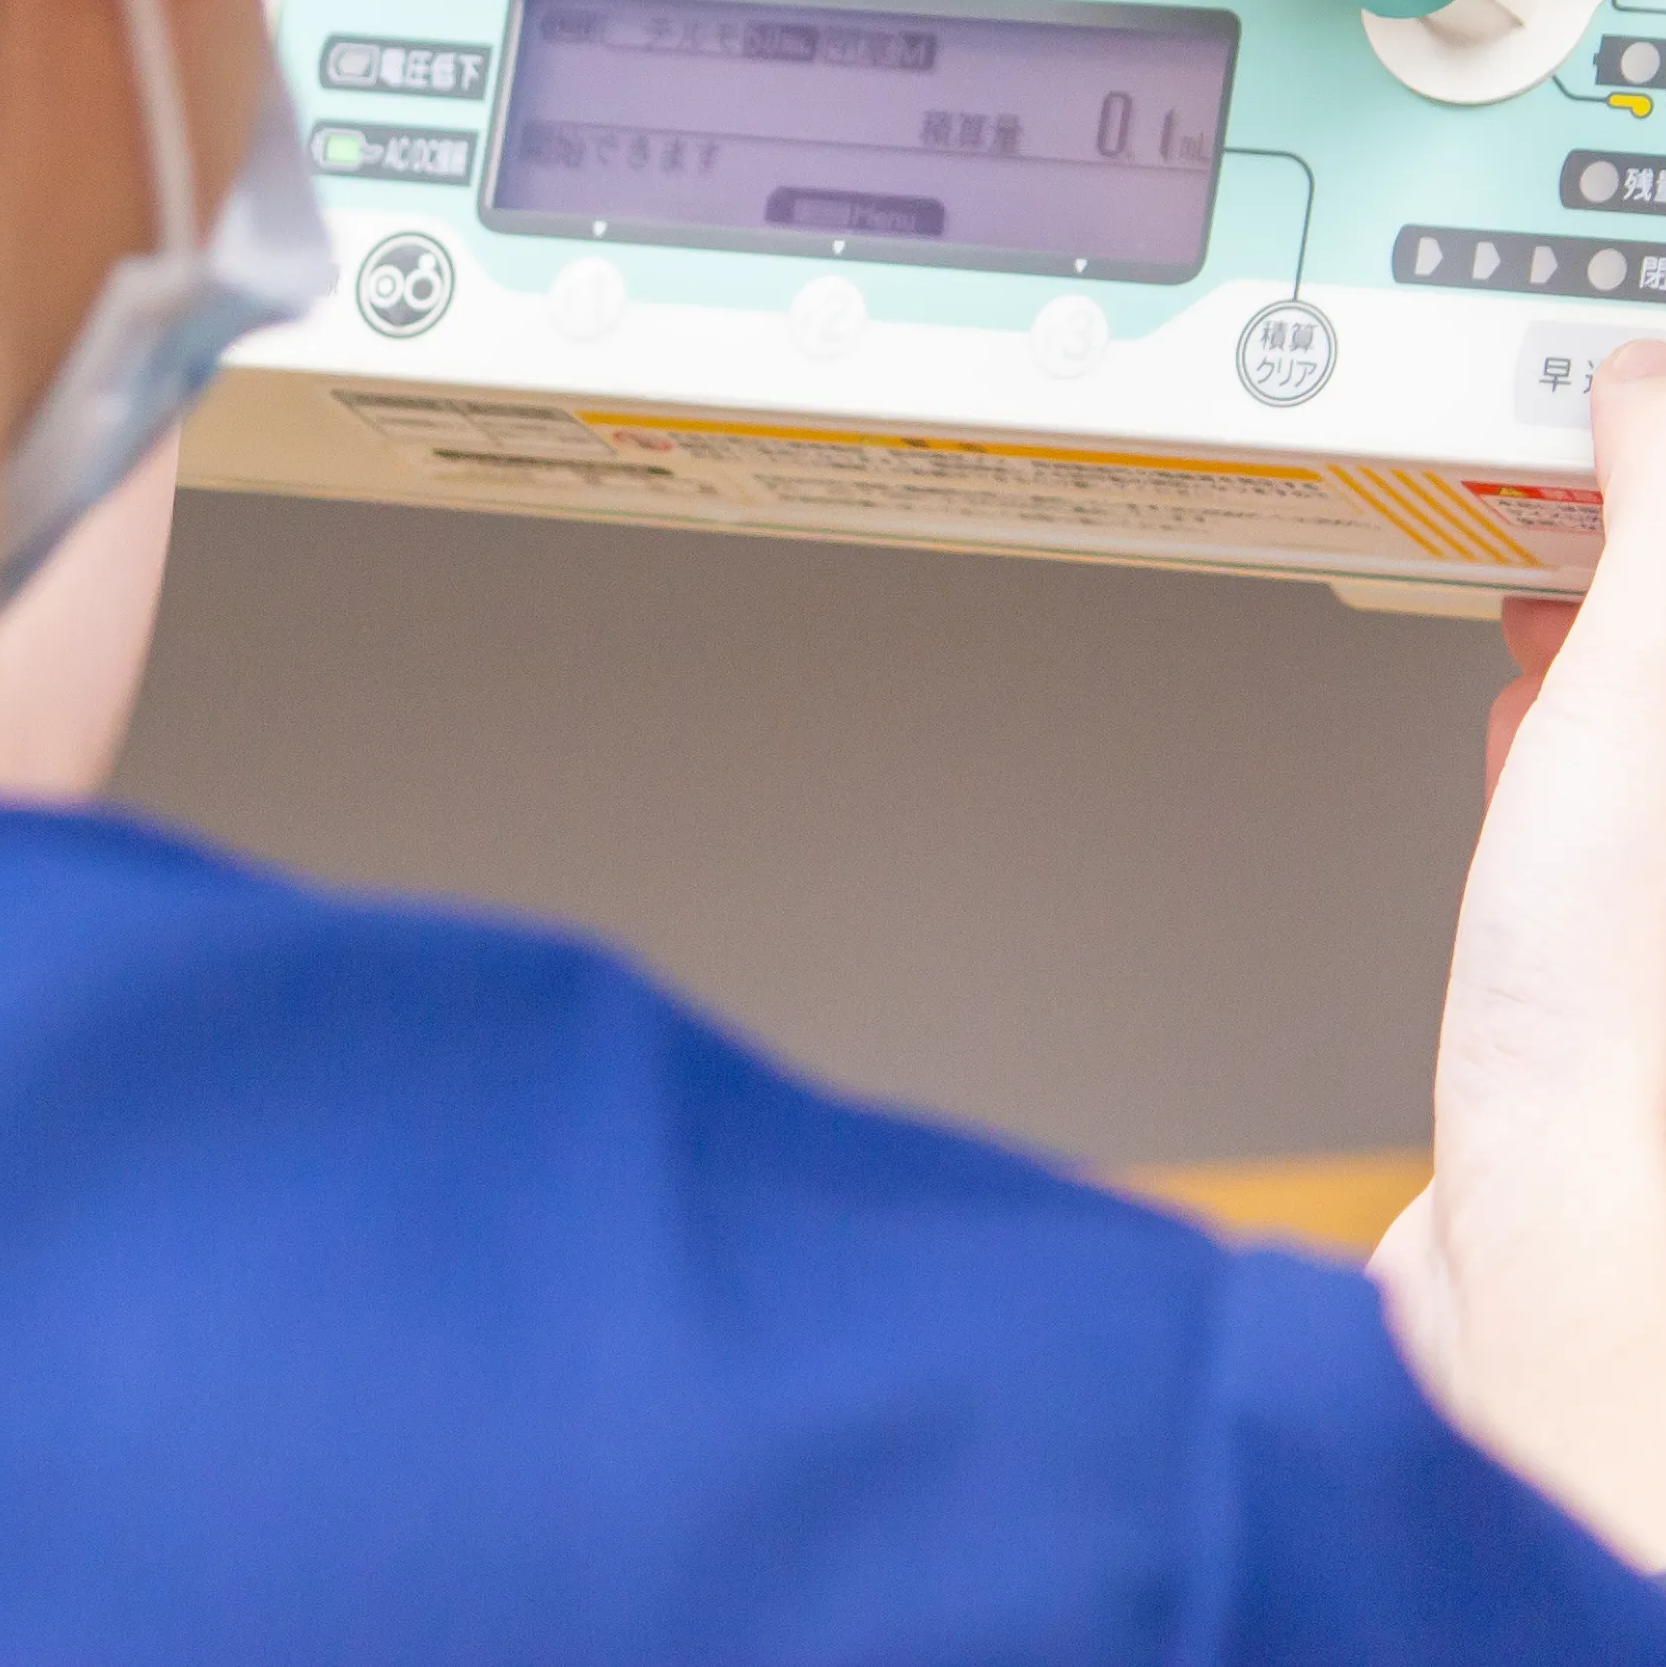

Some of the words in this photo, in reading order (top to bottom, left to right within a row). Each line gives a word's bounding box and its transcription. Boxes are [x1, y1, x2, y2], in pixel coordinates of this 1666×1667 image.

[1255, 355, 1318, 389] クリア
[1538, 356, 1595, 395] 早
